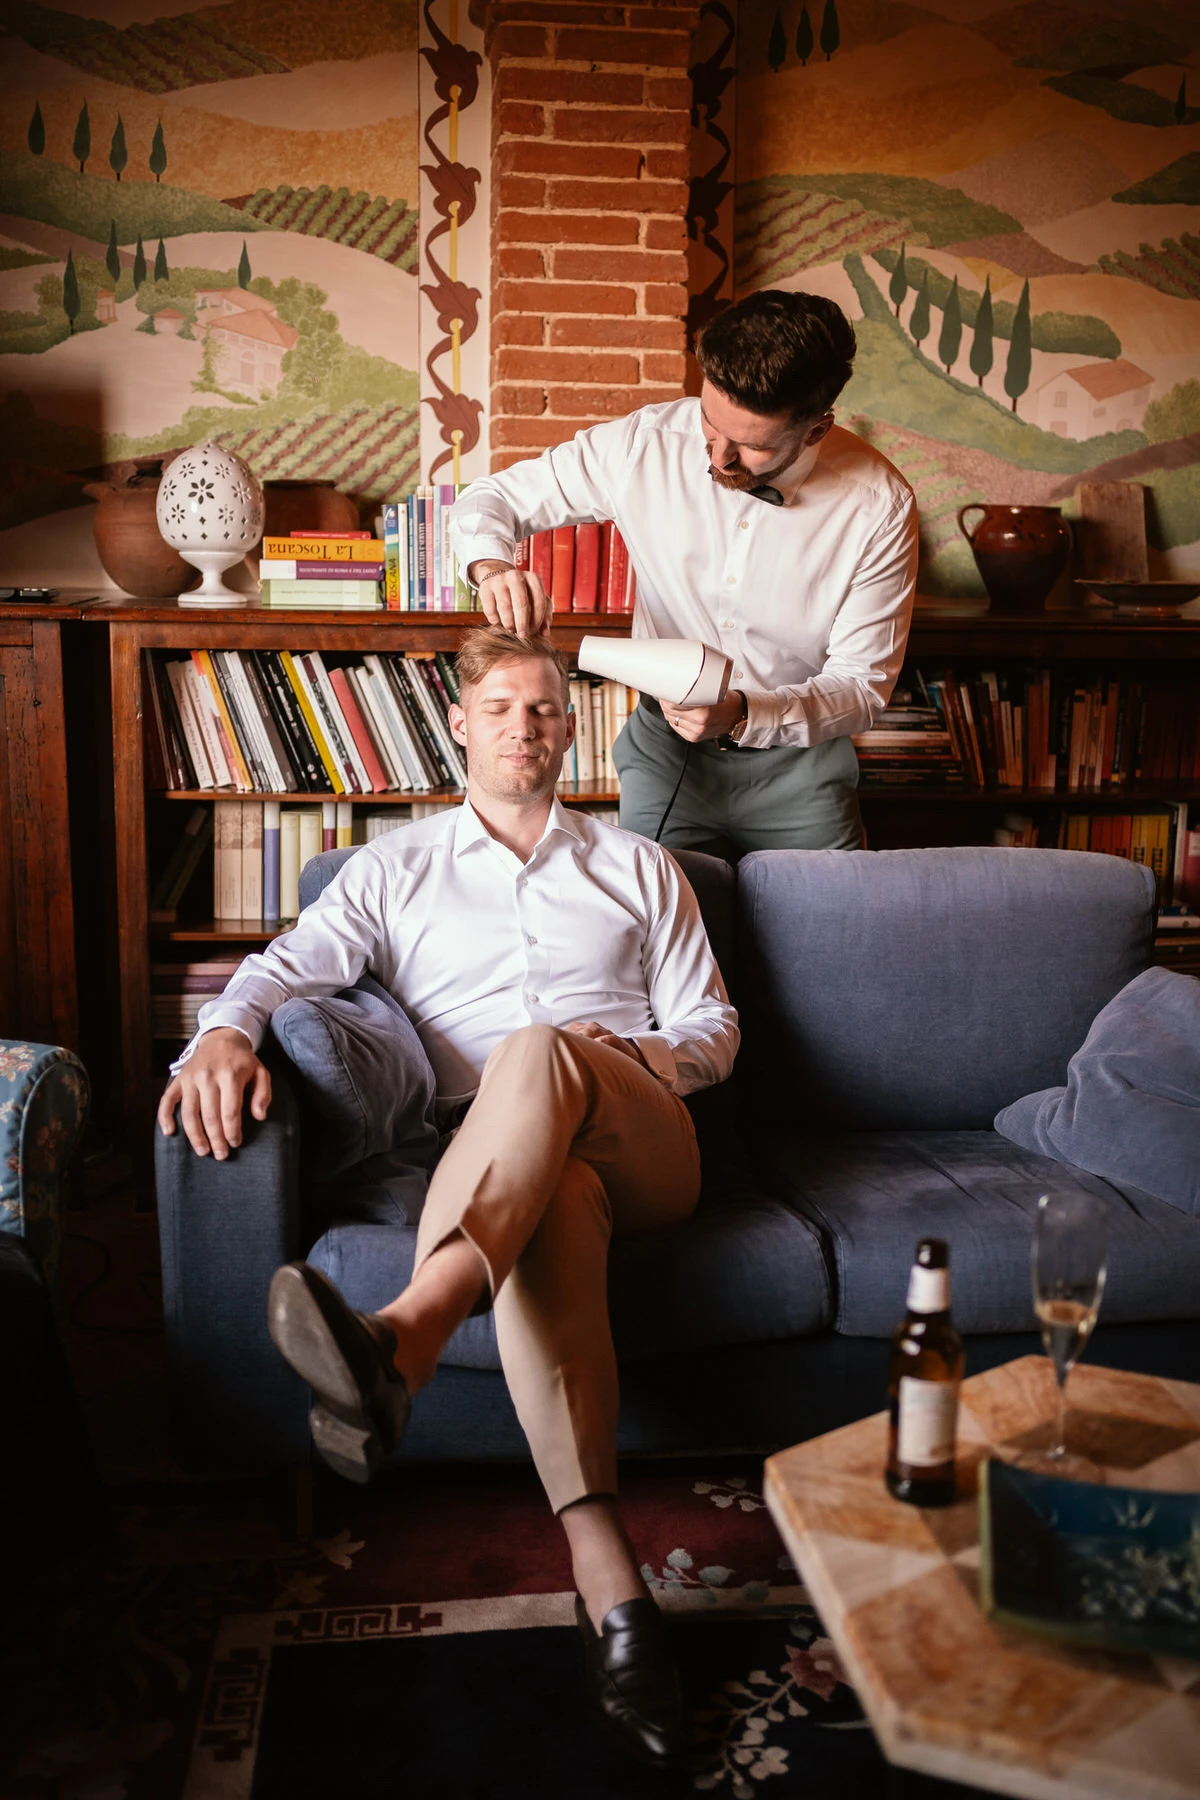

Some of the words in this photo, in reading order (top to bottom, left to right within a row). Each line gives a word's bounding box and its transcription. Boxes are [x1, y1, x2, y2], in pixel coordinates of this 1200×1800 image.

[268, 543, 332, 559] Toscana
[336, 545, 354, 560] La
[388, 558, 398, 604] TOSCANA
